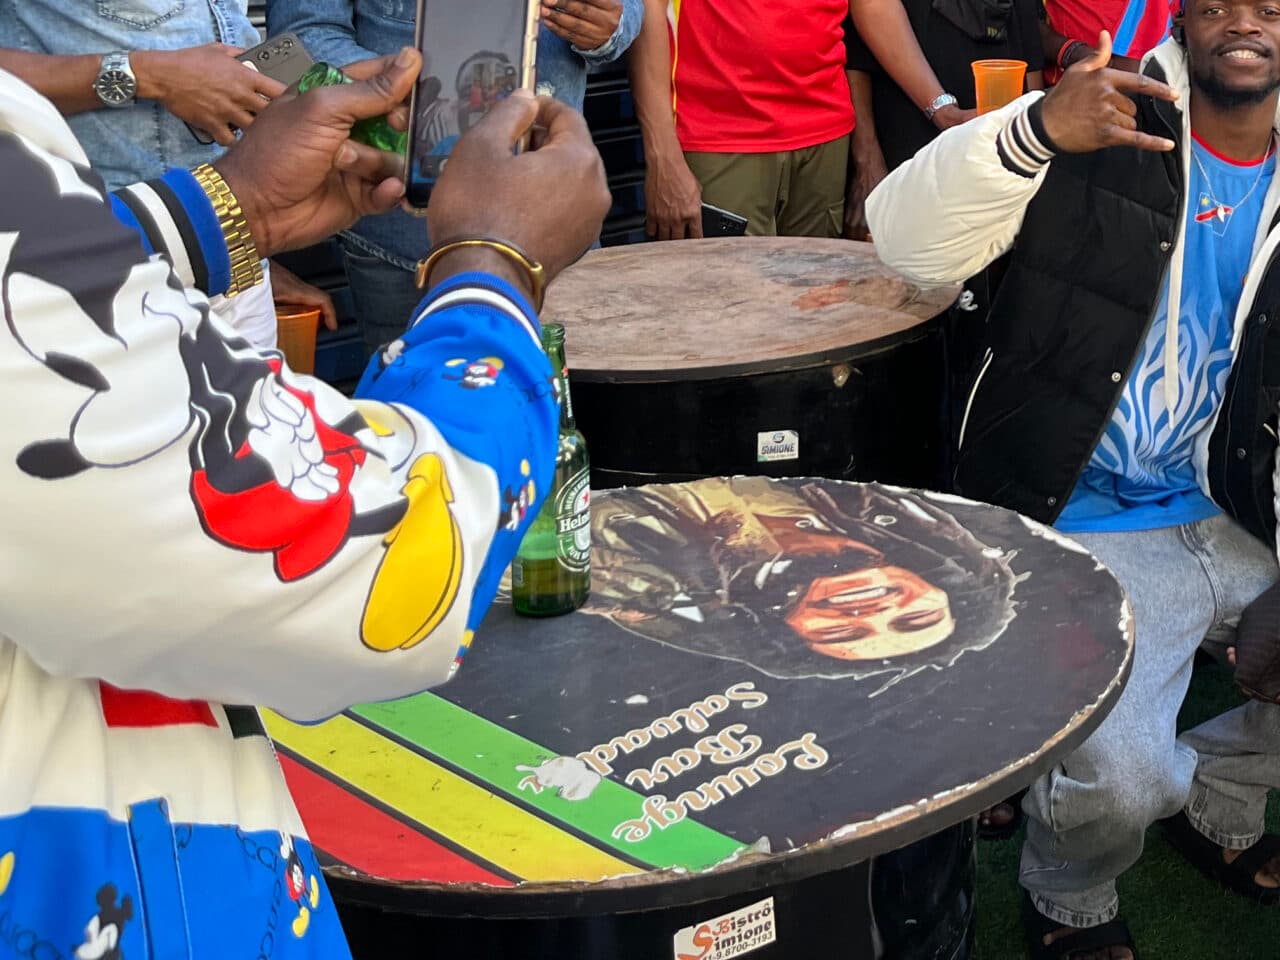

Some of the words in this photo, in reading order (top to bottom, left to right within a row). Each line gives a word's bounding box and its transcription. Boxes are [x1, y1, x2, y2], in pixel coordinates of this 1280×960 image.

[761, 443, 795, 455] SIMIONE
[518, 681, 768, 794] Salvadr
[625, 724, 762, 790] Bar
[611, 733, 829, 843] Lounge
[712, 902, 771, 936] Bistrô
